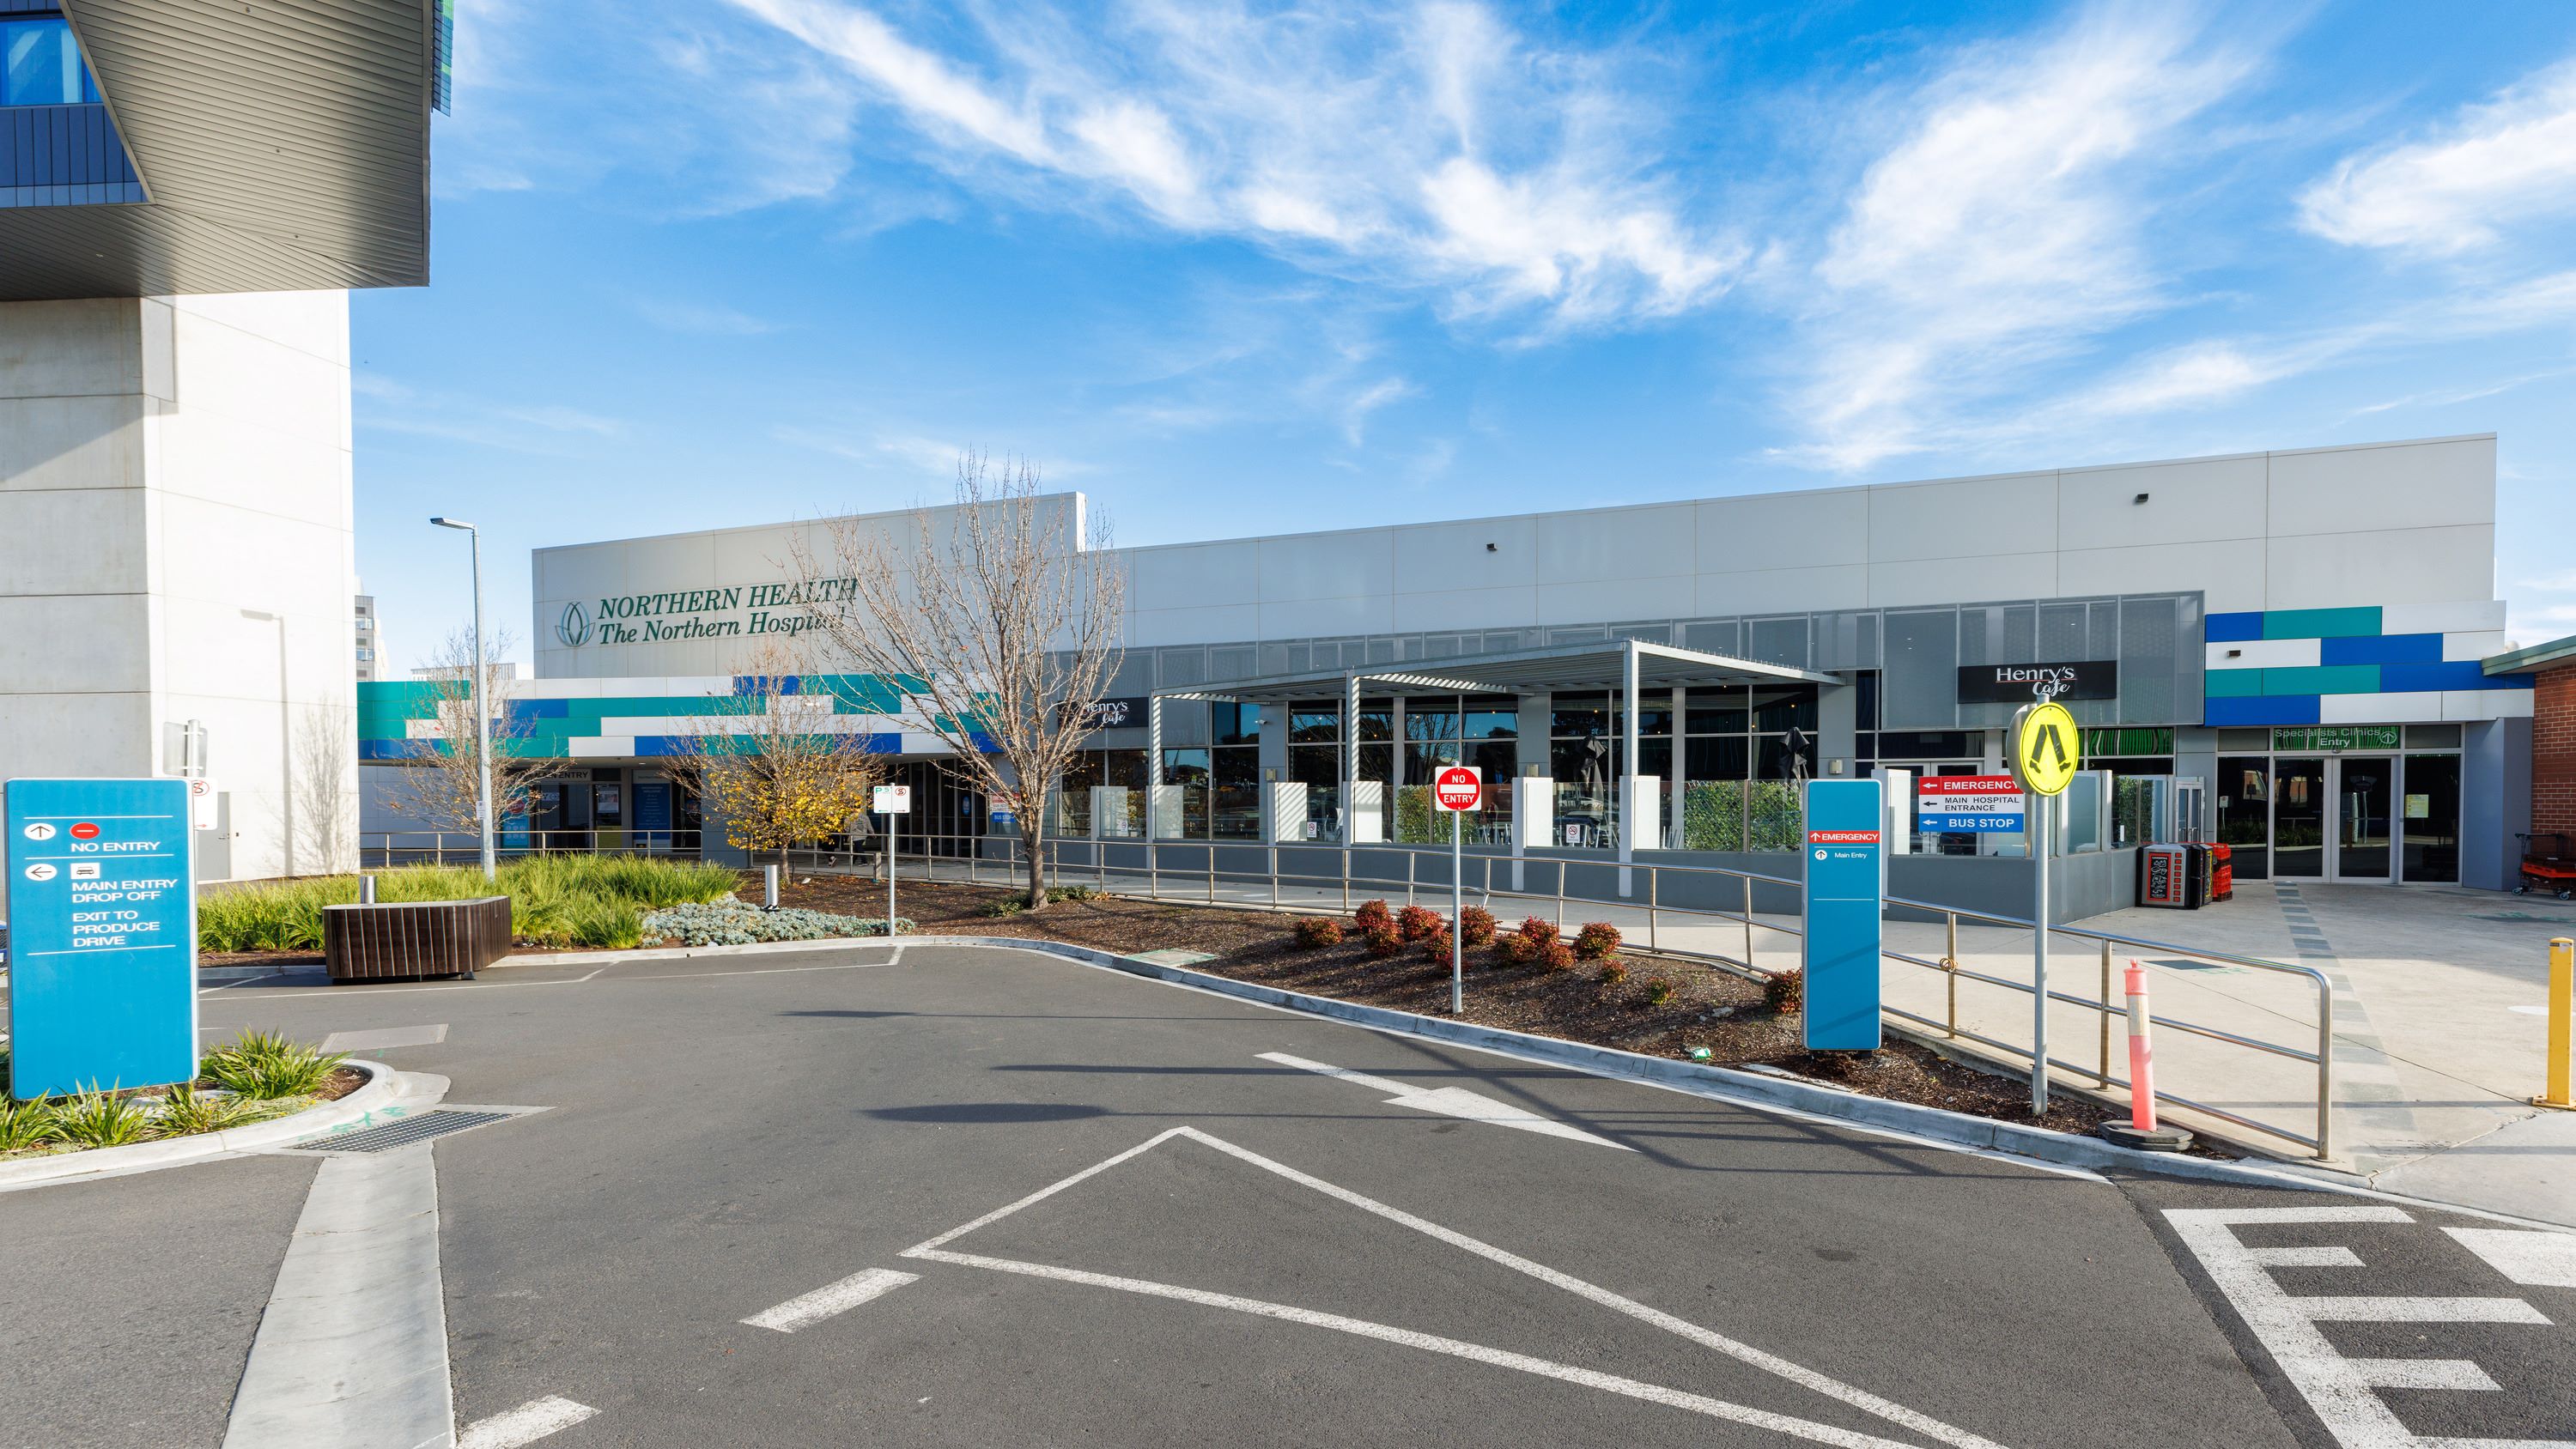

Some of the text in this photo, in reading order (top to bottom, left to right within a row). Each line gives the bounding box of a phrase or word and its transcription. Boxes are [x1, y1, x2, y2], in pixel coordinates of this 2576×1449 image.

[598, 578, 859, 620] NORTHERN HEALTH
[599, 623, 637, 645] The
[642, 616, 741, 642] Northern
[1996, 666, 2075, 683] Henry's
[2032, 678, 2070, 697] Cafe
[2275, 728, 2381, 738] Specialists Clinics
[2320, 738, 2350, 747] Entry
[1452, 774, 1466, 784] NO
[1944, 780, 2018, 790] EMERGENCY
[1443, 794, 1475, 803] ENTRY
[1948, 818, 2014, 828] BUS STOP
[70, 841, 161, 852] NO ENTRY
[72, 879, 178, 891] MAIN ENTRY
[72, 891, 161, 903] DROP OFF
[72, 910, 138, 922] EXIT TO
[73, 921, 161, 935] PRODUCE
[73, 936, 126, 948] DRIVE
